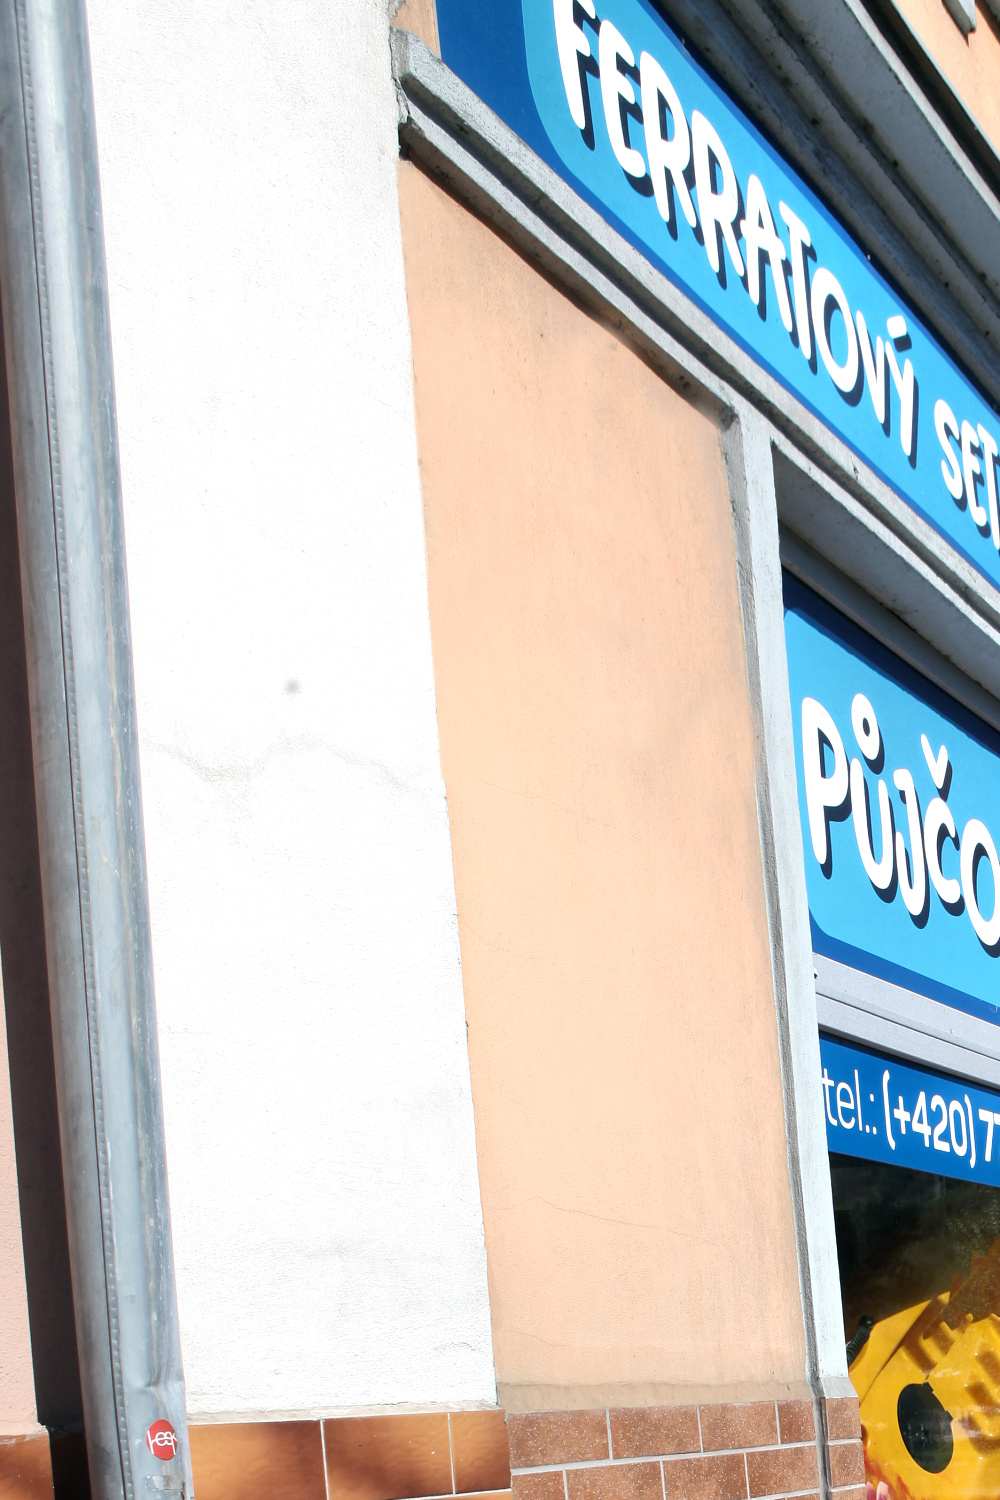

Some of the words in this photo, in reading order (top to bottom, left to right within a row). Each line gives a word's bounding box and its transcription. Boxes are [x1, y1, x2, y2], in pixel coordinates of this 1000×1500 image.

[553, 0, 917, 469] FERRATOVÝ
[934, 398, 1000, 551] SET
[821, 1067, 878, 1136] tel.:
[881, 1069, 977, 1169] (+420)
